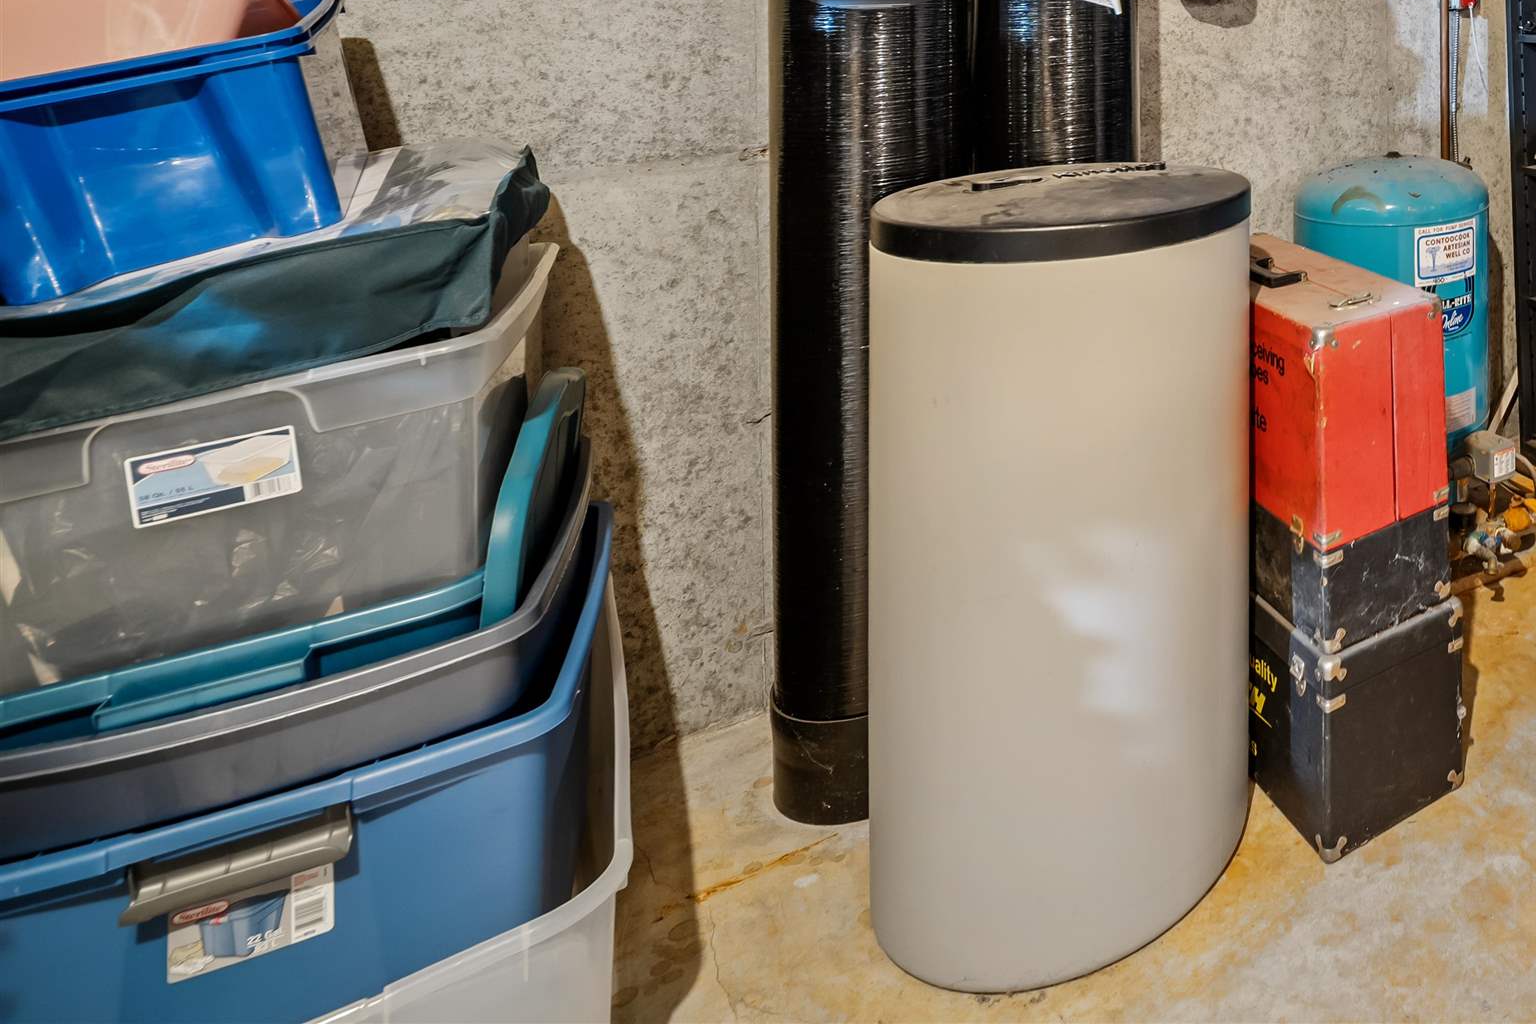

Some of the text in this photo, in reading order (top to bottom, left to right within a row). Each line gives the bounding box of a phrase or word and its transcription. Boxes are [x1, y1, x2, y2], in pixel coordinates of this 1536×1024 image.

[1418, 227, 1432, 235] CALL
[1425, 232, 1471, 246] CONTOOCOOK
[1443, 240, 1471, 252] ARTESIAN
[1446, 250, 1461, 259] WELL
[1442, 295, 1472, 310] LL-RITE
[1250, 656, 1278, 693] uality
